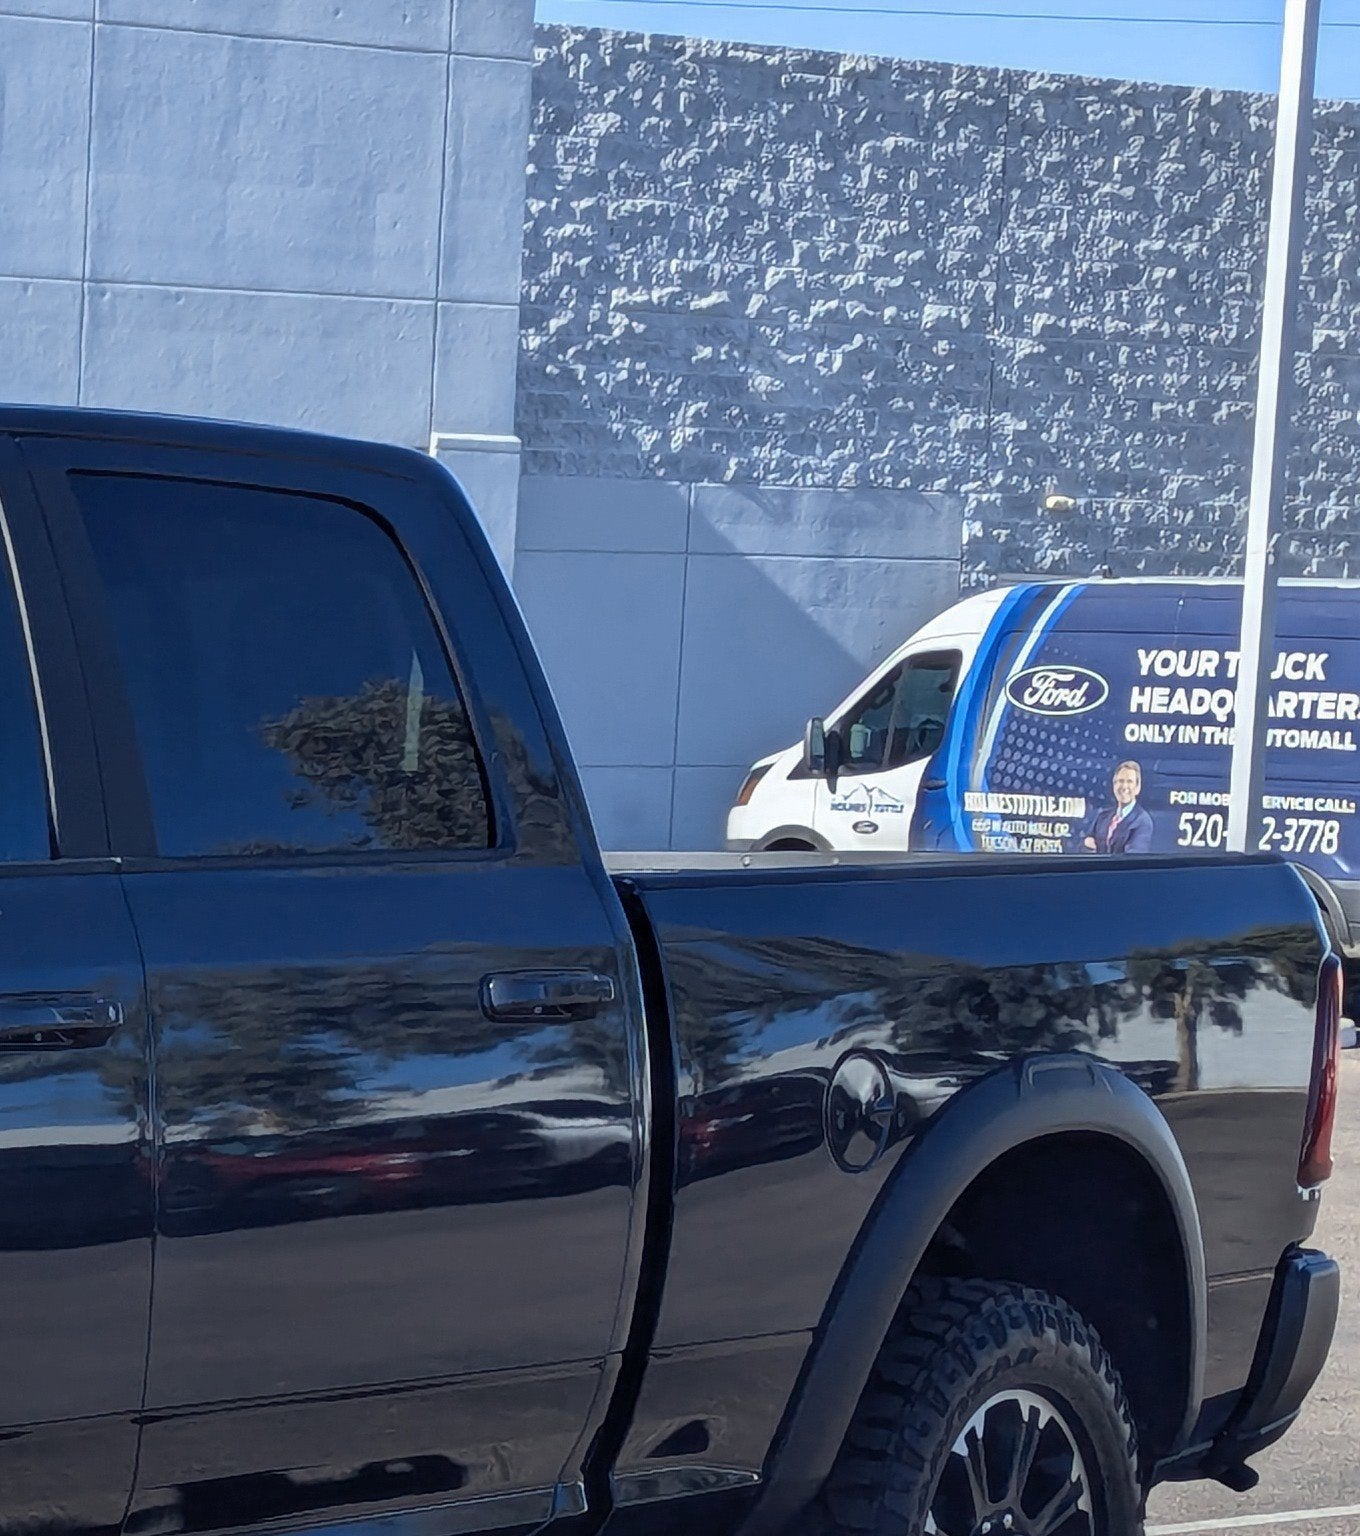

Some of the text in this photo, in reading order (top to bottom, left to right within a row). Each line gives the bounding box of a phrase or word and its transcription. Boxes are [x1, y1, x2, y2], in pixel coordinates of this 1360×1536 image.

[1137, 648, 1329, 681] YOUR TUCK
[1023, 671, 1090, 707] Ford
[1129, 686, 1360, 723] HEADQRTER
[1124, 723, 1177, 744] ONLY
[1178, 724, 1200, 744] IN
[1265, 728, 1357, 750] TOMALL
[1169, 791, 1198, 806] FOR
[1198, 792, 1231, 806] MOB
[1262, 795, 1314, 812] ERVICE
[1177, 811, 1341, 855] 520-2-3778
